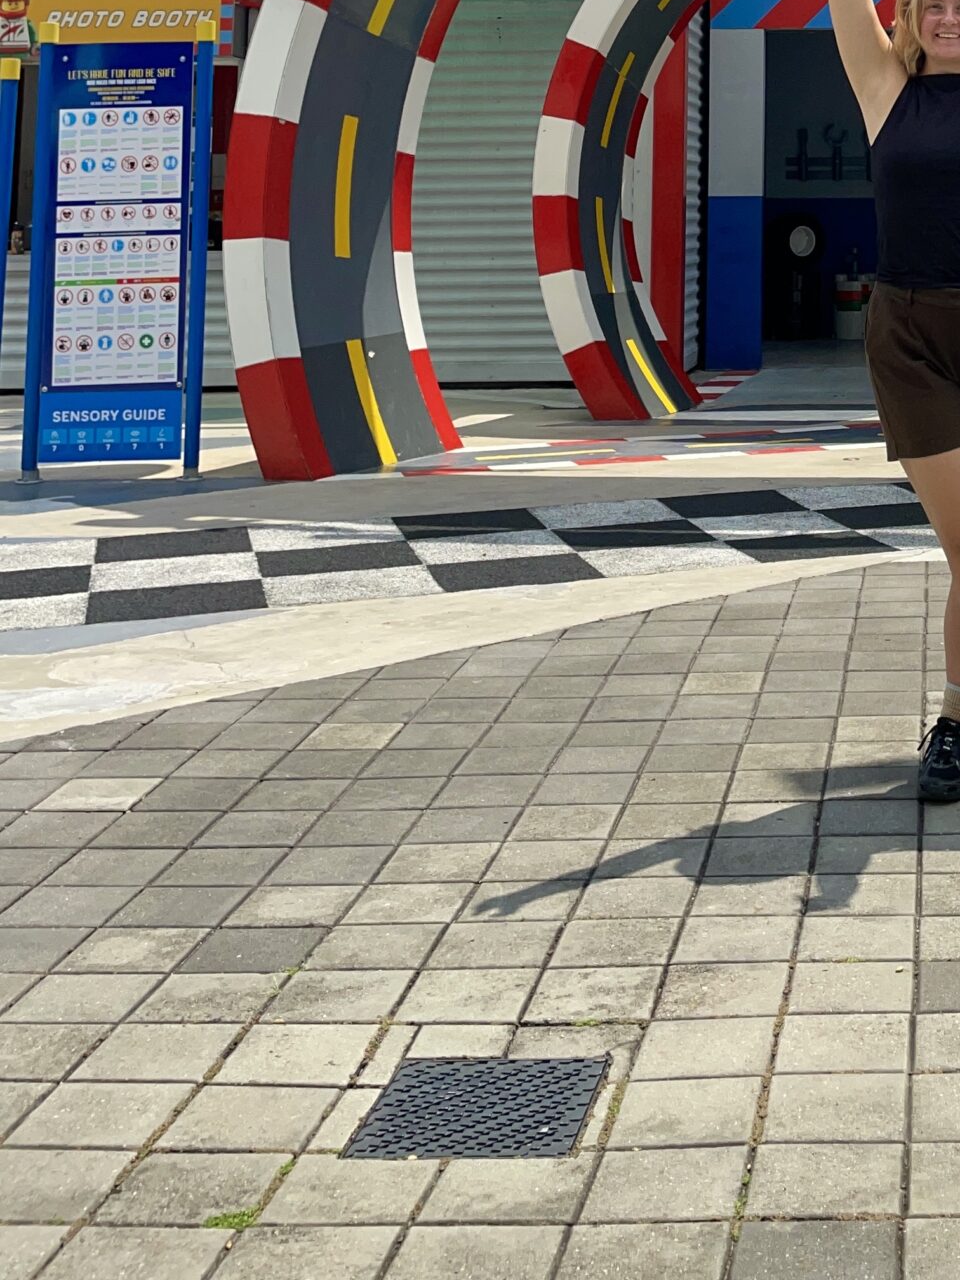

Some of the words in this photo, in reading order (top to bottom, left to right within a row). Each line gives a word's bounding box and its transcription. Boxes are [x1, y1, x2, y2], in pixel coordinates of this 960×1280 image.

[47, 10, 125, 28] PHOTO
[132, 10, 213, 28] BOOTH
[67, 70, 89, 80] LET'S
[111, 68, 126, 79] FUN
[128, 68, 144, 78] AND
[145, 68, 155, 78] BE
[157, 67, 176, 78] SAFE
[52, 410, 119, 423] SENSORY
[122, 409, 166, 421] GUIDE
